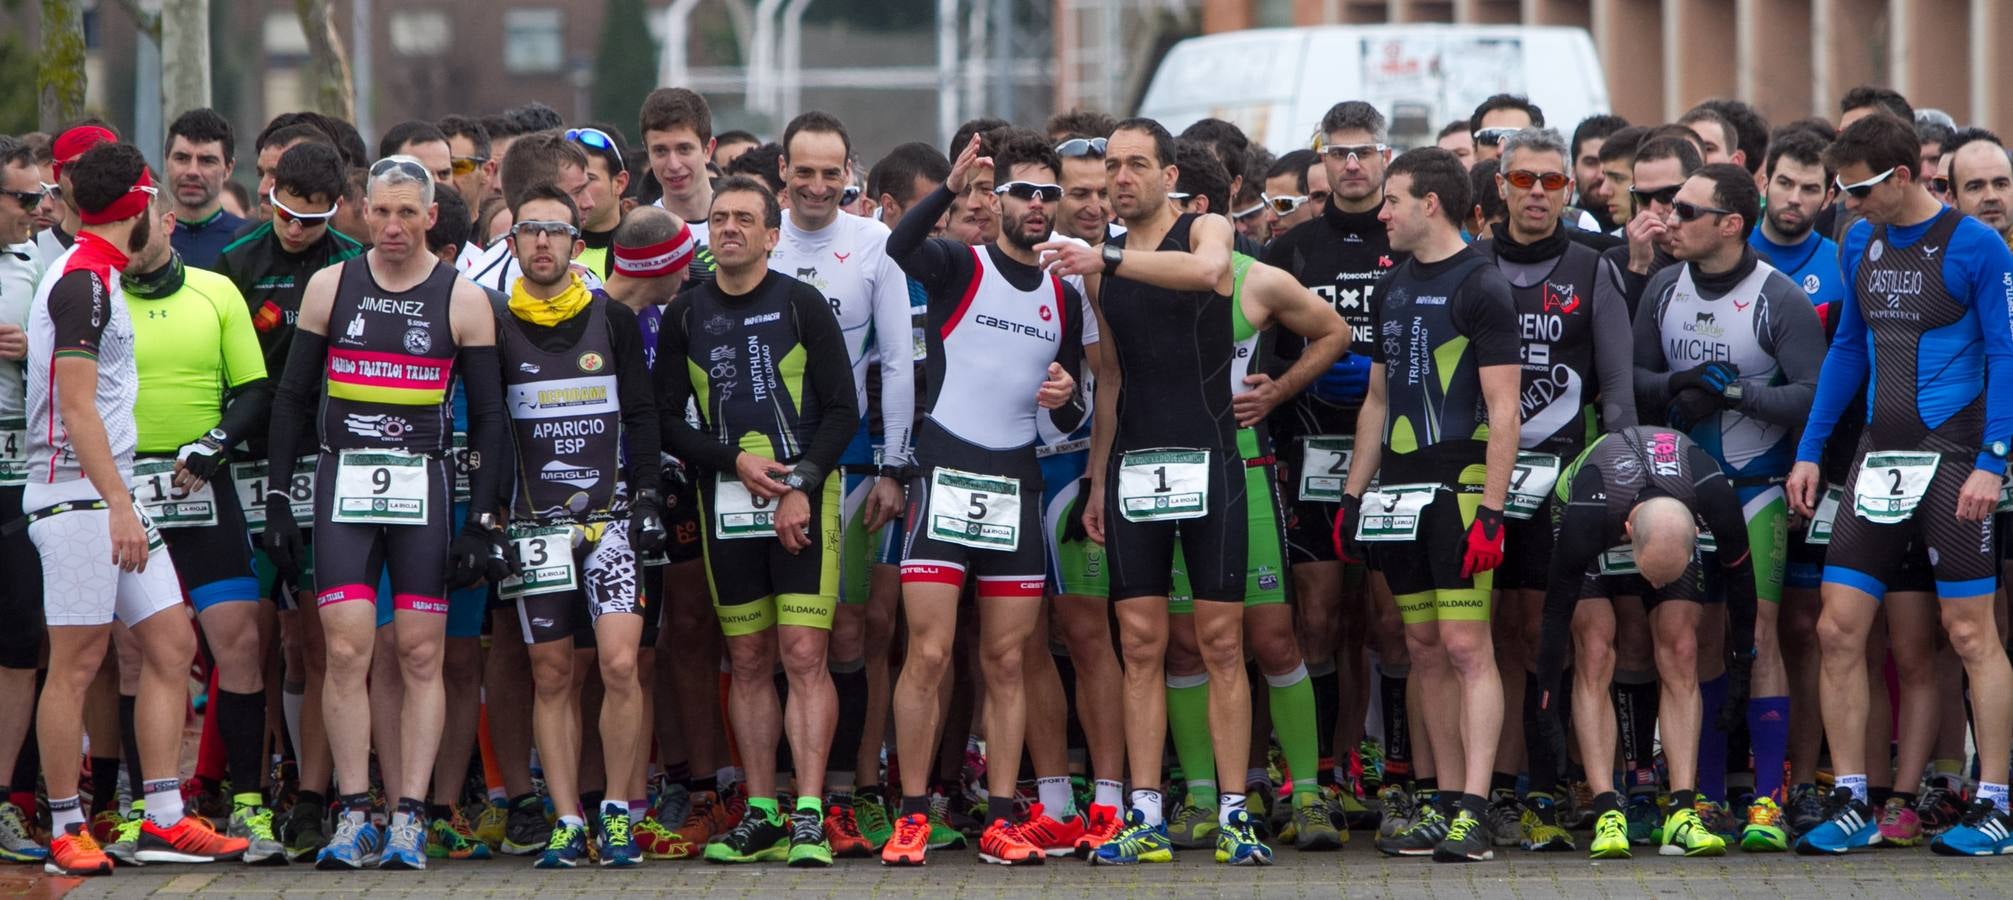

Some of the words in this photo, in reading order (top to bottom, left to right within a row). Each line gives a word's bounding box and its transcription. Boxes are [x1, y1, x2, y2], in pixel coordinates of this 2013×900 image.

[1868, 269, 1922, 294] CASTILLEJO
[357, 296, 424, 317] JIMENEZ
[1349, 325, 1374, 342] NE
[1408, 316, 1422, 386] TRIATHLON
[1421, 328, 1430, 375] GALDAKAO
[747, 335, 767, 402] TRIATHLON
[761, 344, 777, 389] GALDAKAO
[533, 418, 605, 438] APARICIO
[554, 438, 586, 455] ESP
[372, 467, 391, 495] 9
[540, 468, 600, 481] MAGLIA
[1154, 466, 1172, 493] 1
[1511, 465, 1532, 490] 7
[1887, 468, 1904, 496] 2
[967, 492, 988, 520] 5
[782, 604, 828, 616] GALDAKAO
